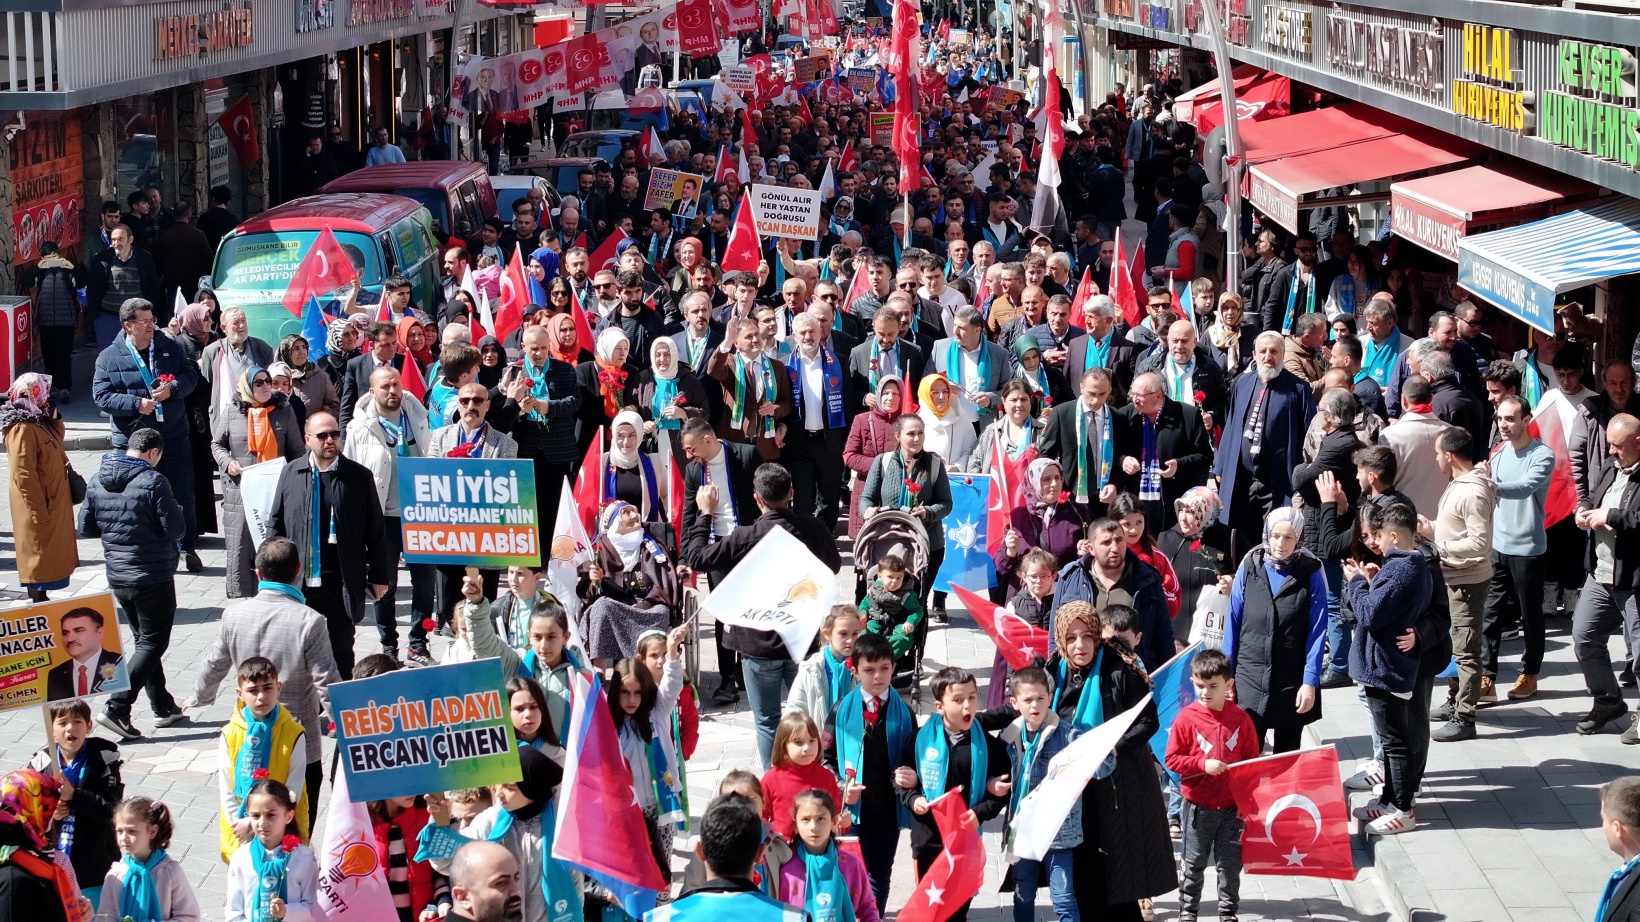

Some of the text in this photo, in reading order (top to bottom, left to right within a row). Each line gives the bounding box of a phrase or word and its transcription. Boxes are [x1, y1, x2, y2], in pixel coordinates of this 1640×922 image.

[1463, 23, 1513, 82] HİLAL
[1559, 39, 1623, 97] KEVSER
[523, 91, 544, 104] MHP
[1453, 80, 1525, 136] KURUYEMİŞ
[1543, 90, 1638, 172] KURUYEMİŞ
[654, 172, 678, 182] SEFER
[652, 180, 673, 190] BİZİM
[650, 189, 675, 200] ZAFER
[761, 192, 811, 204] GÖNÜL ALIR
[761, 202, 811, 214] HER YAŞTAN
[764, 212, 805, 223] DOĞRUSU
[757, 220, 816, 236] RCAN BAŞKAN
[233, 276, 248, 285] AK
[415, 469, 519, 504] EN İYİSİ
[406, 527, 535, 554] ERCAN ABİSİ
[739, 608, 762, 621] AK
[0, 633, 56, 657] NACAK
[26, 656, 46, 667] İÇİN
[6, 688, 38, 700] ÇİMEN
[339, 689, 504, 739] REİS'İN ADAYI
[347, 725, 510, 774] ERCAN ÇİMEN
[319, 875, 348, 914] PARTİ
